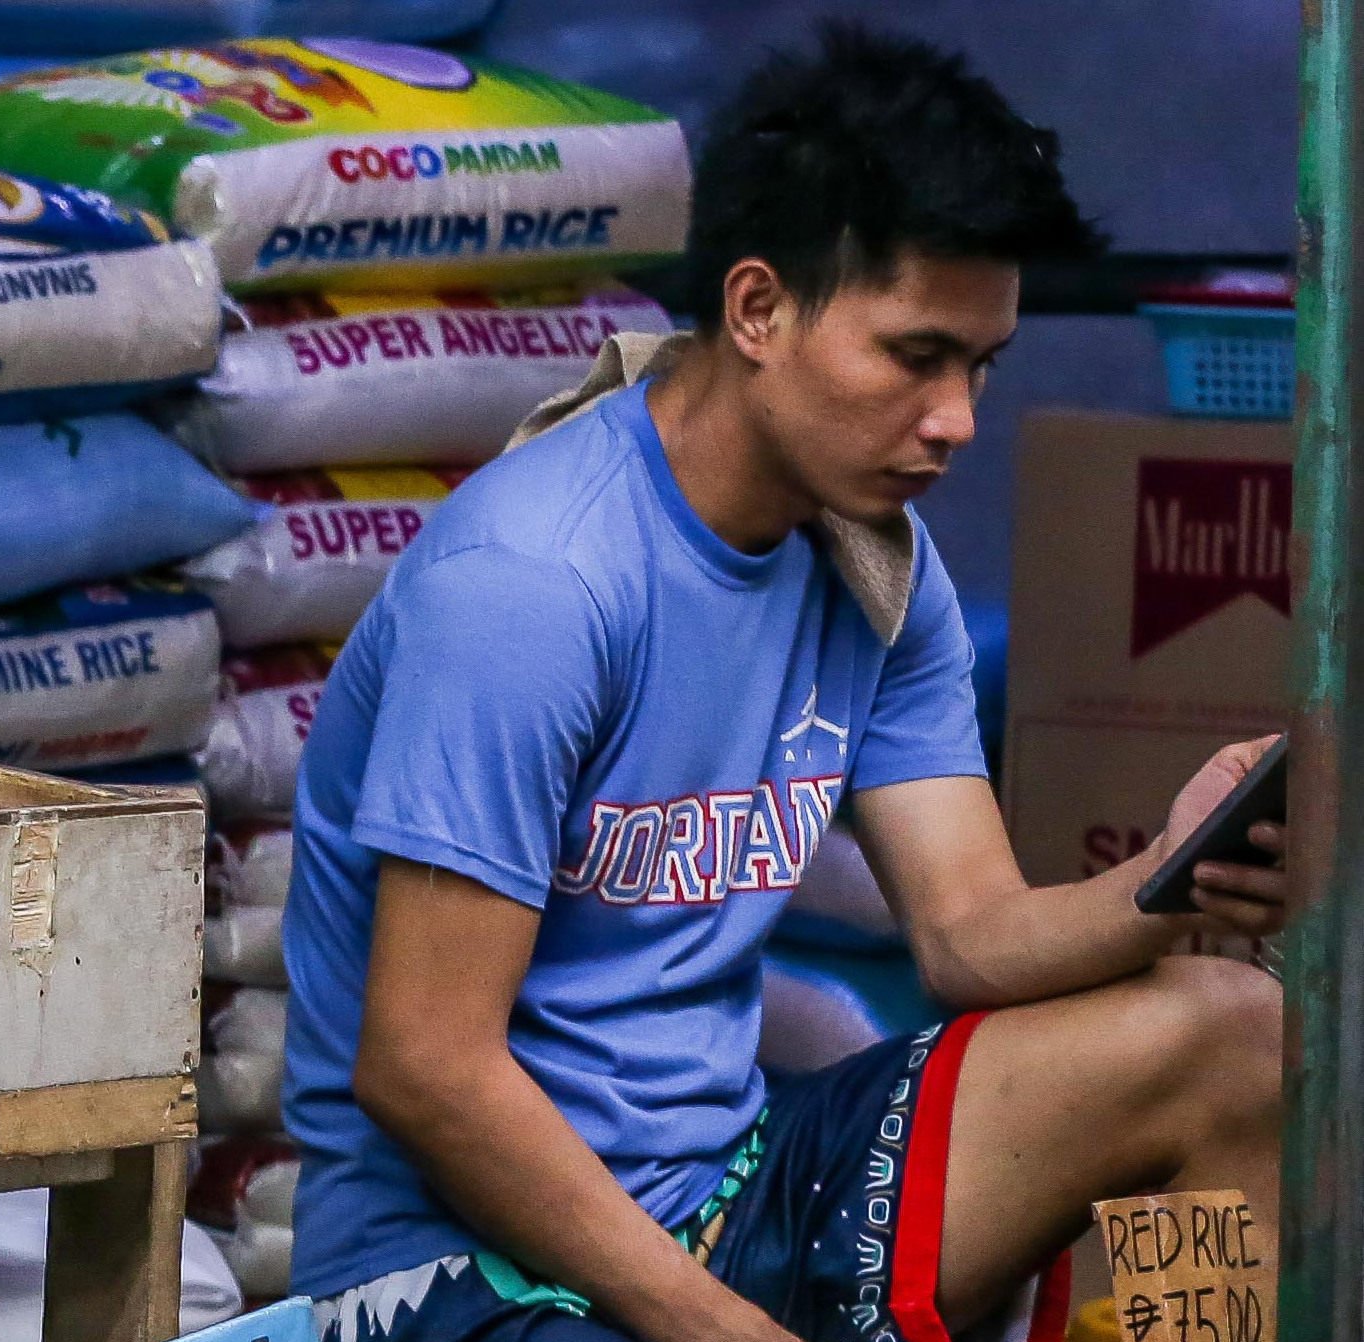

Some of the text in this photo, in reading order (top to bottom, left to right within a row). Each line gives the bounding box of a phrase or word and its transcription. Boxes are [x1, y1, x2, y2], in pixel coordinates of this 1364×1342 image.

[329, 142, 442, 184] COCO
[258, 206, 619, 268] PREMIUM RICE
[286, 311, 620, 377] SUPER ANGELICA
[74, 630, 160, 684] RICE
[1108, 1203, 1262, 1277] RED RICE
